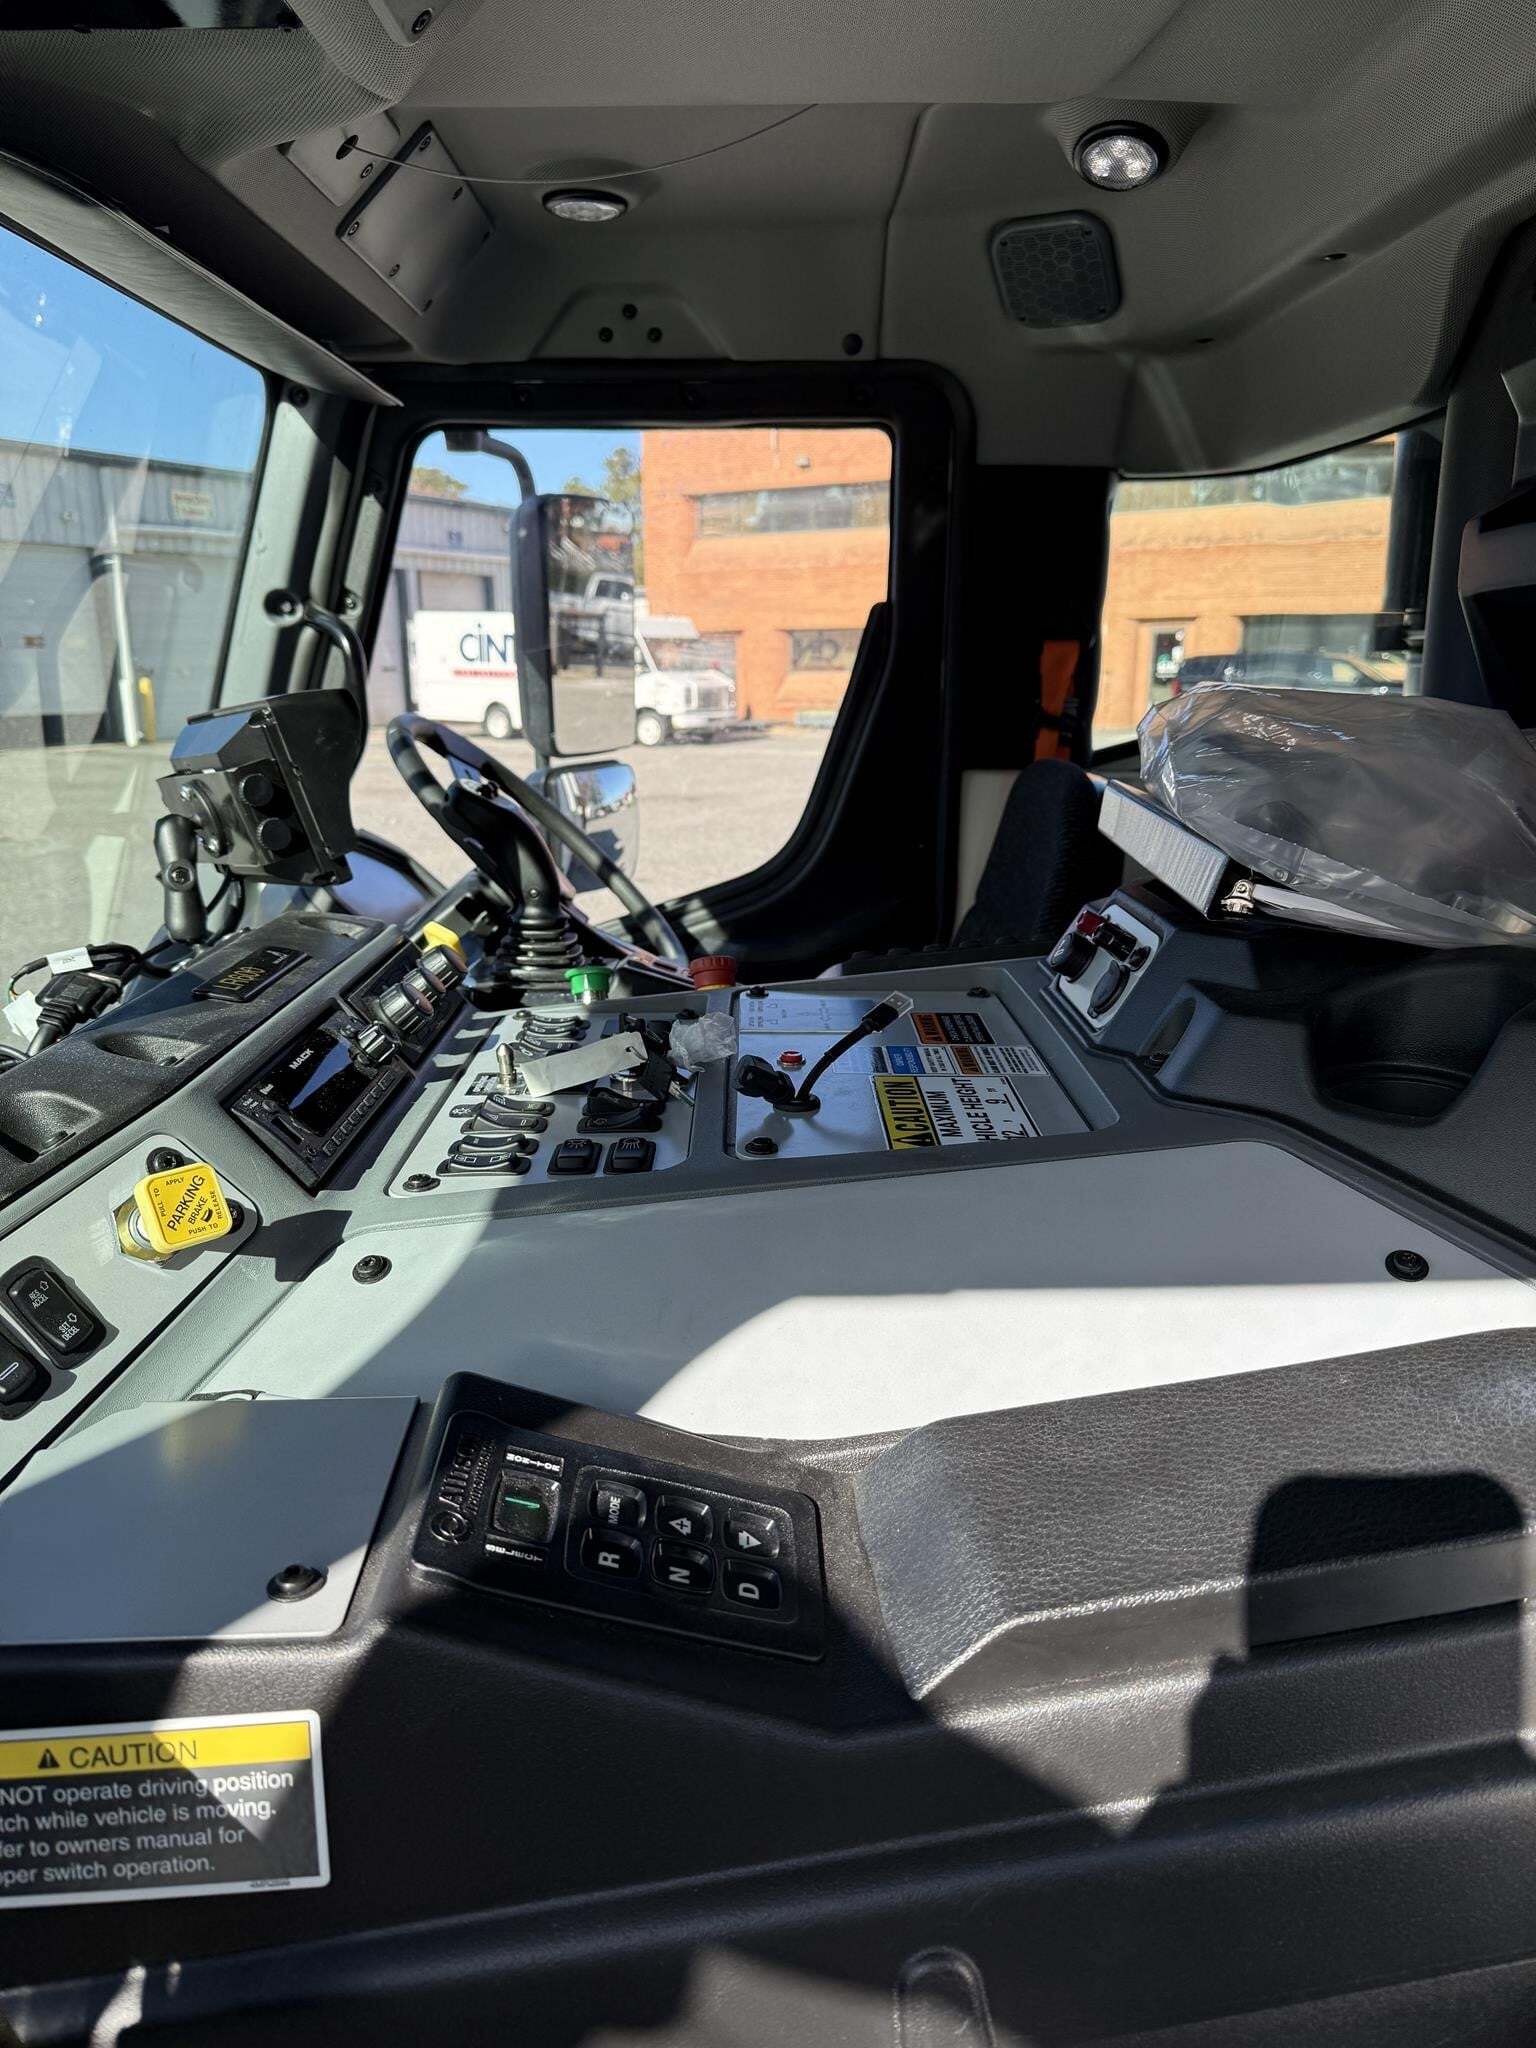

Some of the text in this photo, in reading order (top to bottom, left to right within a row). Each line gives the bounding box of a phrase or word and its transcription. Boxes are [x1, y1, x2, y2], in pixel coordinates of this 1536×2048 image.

[288, 1048, 315, 1071] MACK
[883, 1081, 930, 1132] CAUTION
[951, 1077, 985, 1110] HEIGHT
[925, 1090, 963, 1137] MAXIMUM
[153, 1187, 160, 1198] TO
[165, 1177, 185, 1186] APPLY
[167, 1175, 205, 1231] PARKING
[188, 1196, 208, 1225] BRAKE
[188, 1190, 223, 1235] PUSH TO RELEASE
[58, 1321, 71, 1333] SET
[505, 1452, 561, 1472] MONITOR
[607, 1495, 622, 1525] MODE
[485, 1543, 543, 1562] SELECT
[597, 1551, 621, 1569] R
[668, 1565, 691, 1585] N
[738, 1582, 760, 1600] D
[68, 1739, 198, 1769] CAUTION
[0, 1769, 294, 1806] NOT operate driving position
[34, 1809, 89, 1830] while
[94, 1805, 167, 1827] vehicle
[172, 1802, 190, 1822] is
[196, 1798, 277, 1822] moving.
[28, 1840, 50, 1858] to
[55, 1835, 130, 1856] owners
[136, 1828, 212, 1850] manual
[218, 1826, 245, 1844] for
[42, 1860, 107, 1883] switch
[112, 1855, 216, 1882] operation.
